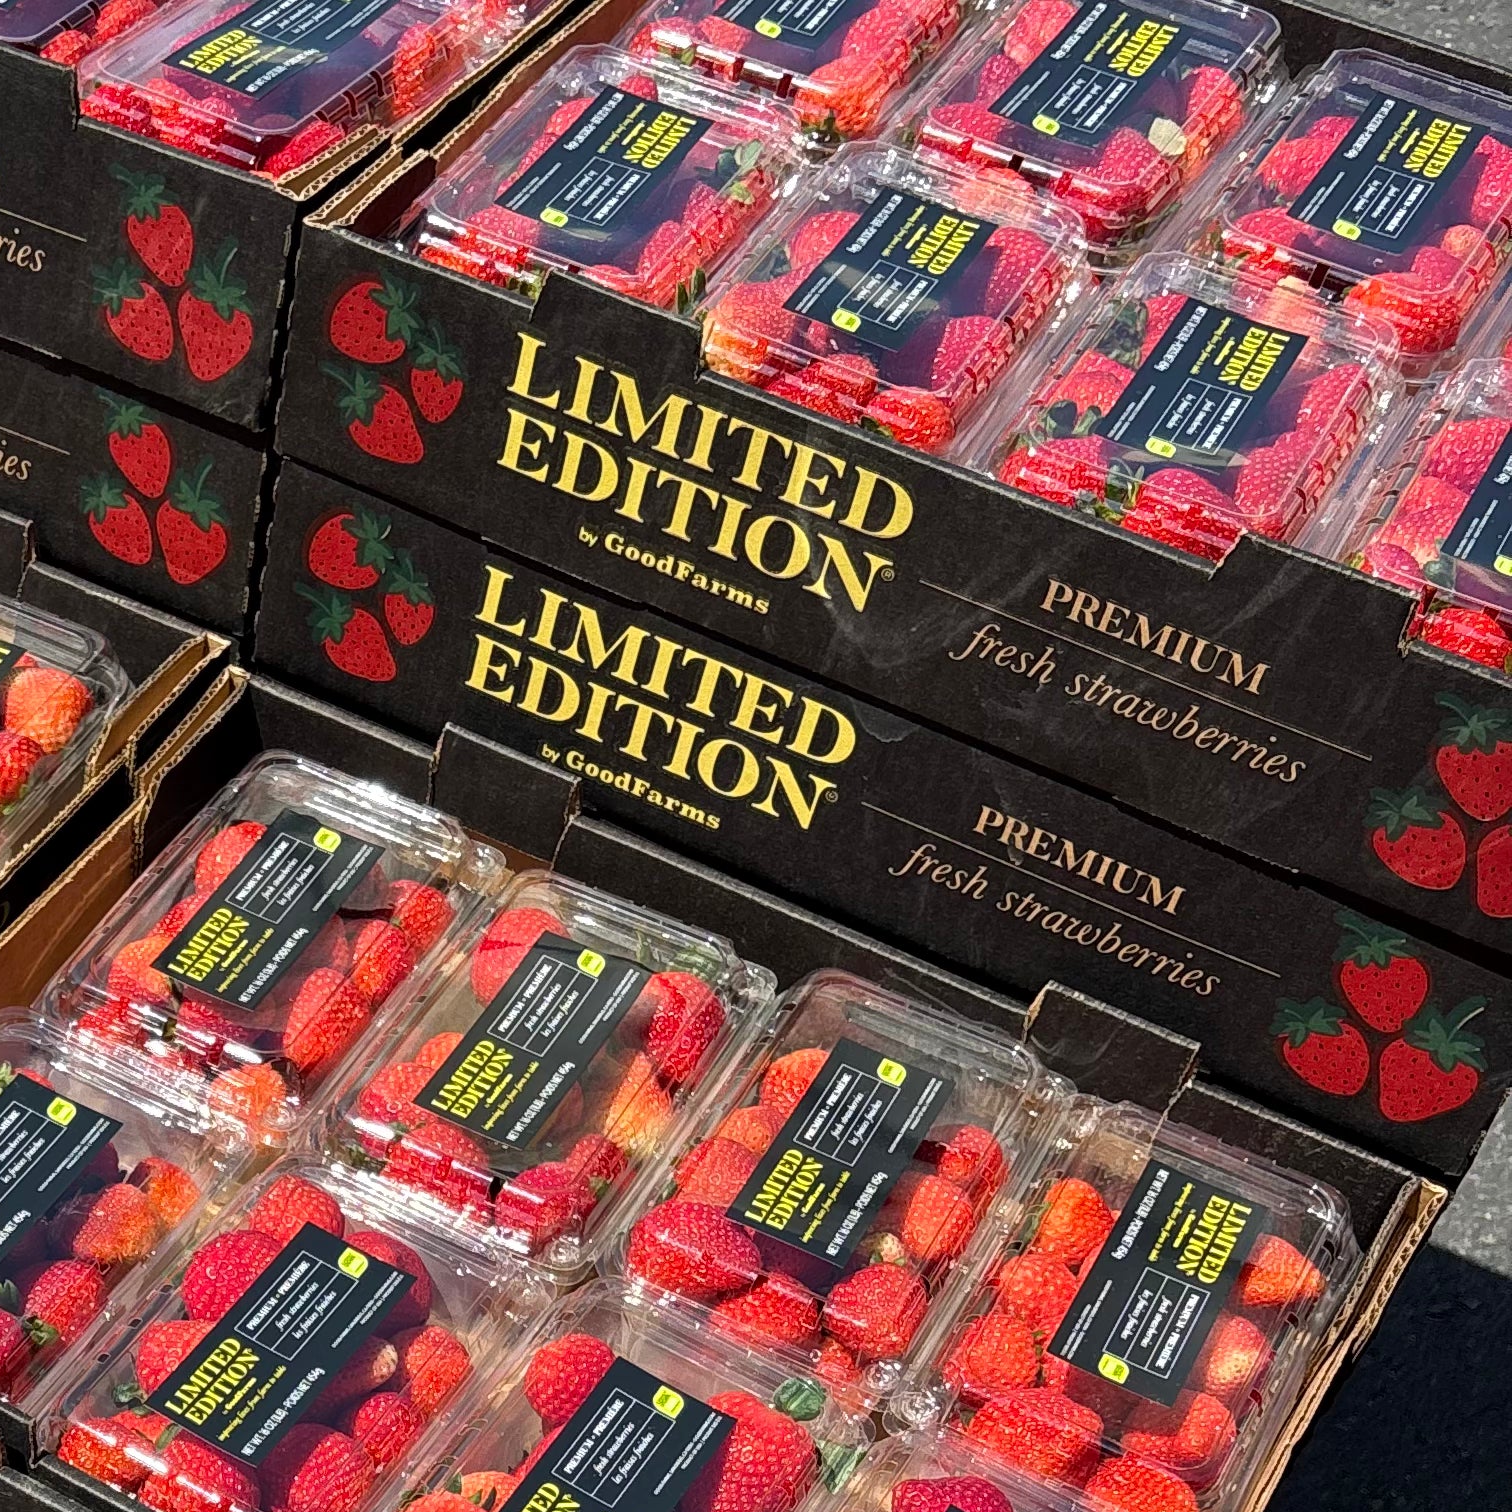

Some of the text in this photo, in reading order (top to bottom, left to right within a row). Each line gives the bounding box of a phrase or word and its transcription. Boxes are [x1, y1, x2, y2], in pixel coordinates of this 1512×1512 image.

[1239, 333, 1290, 391] LIMITED
[507, 331, 914, 540] LIMITED
[578, 526, 770, 615] by GoodFarms
[475, 564, 857, 766] LIMITED
[1039, 578, 1271, 696] PREMIUM
[949, 624, 1306, 784] fresh strawberries
[541, 743, 722, 831] by GoodFarms
[971, 805, 1186, 917] PREMIUM
[168, 908, 231, 975] LIMITED
[888, 844, 1221, 998] fresh strawberries
[432, 1040, 494, 1112] LIMITED
[745, 1149, 803, 1223] LIMITED
[1198, 1202, 1251, 1283] LIMITED
[165, 1338, 240, 1416] LIMITED
